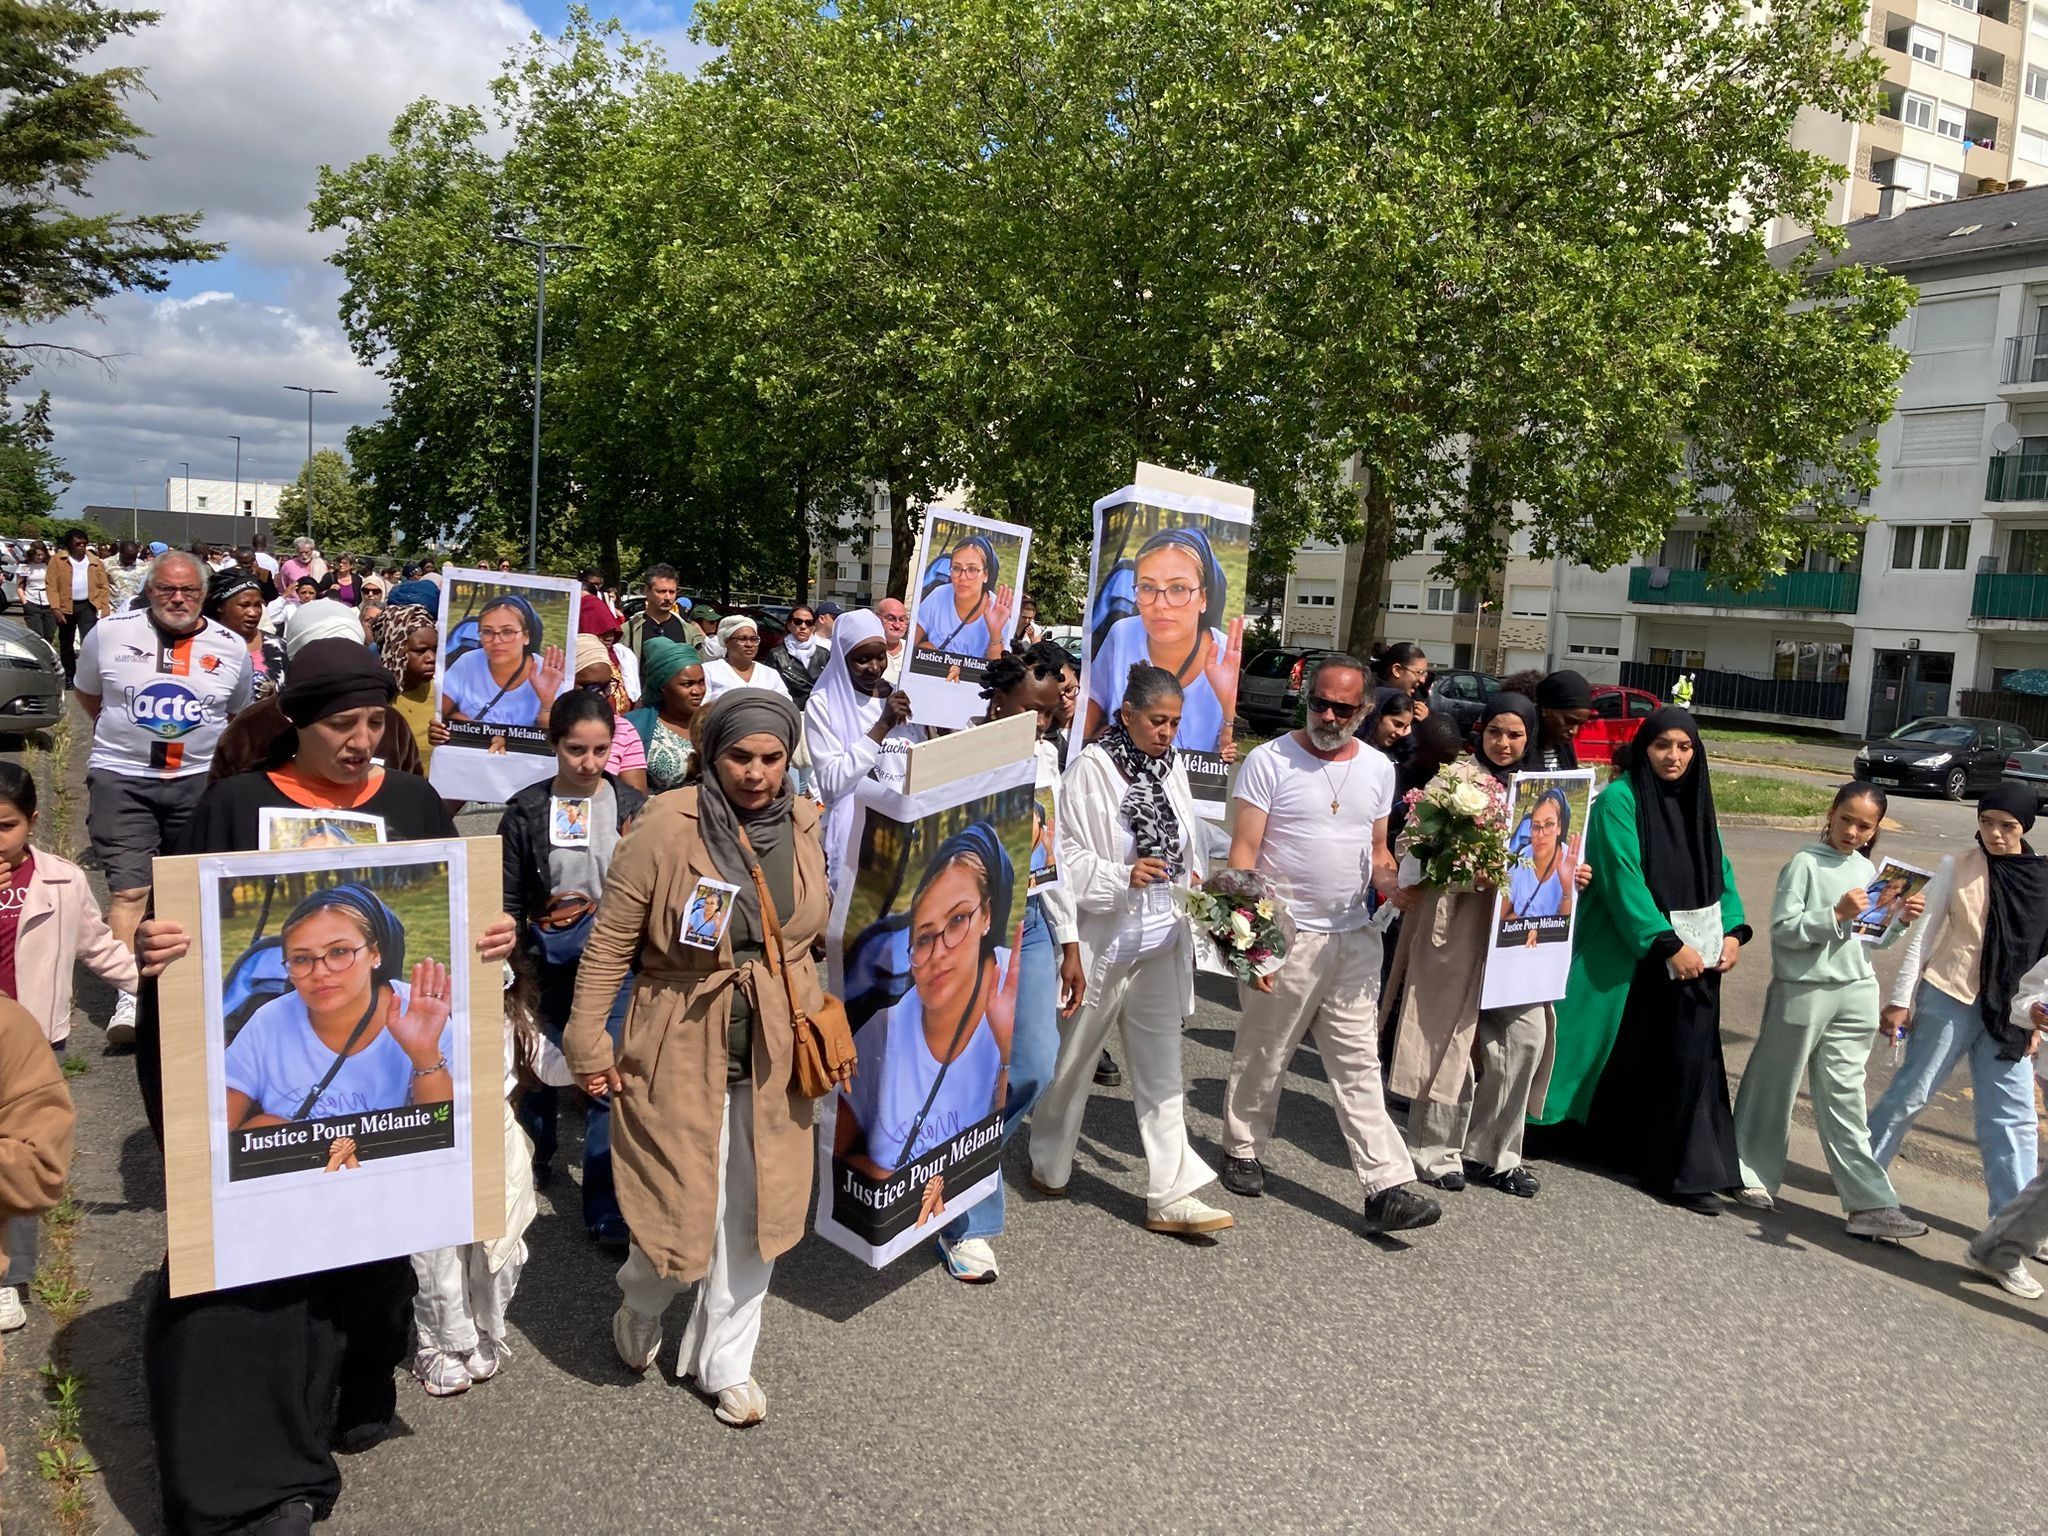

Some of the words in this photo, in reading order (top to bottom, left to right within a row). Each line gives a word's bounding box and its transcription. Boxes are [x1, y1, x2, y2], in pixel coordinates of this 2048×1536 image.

[915, 649, 943, 663] Justice
[943, 653, 962, 667] Pour
[962, 657, 989, 671] Mélan
[446, 720, 481, 734] Justice
[482, 724, 506, 736] Pour
[508, 727, 547, 740] Mélanie
[1502, 921, 1523, 933] Justice
[1523, 919, 1539, 930] Pour
[1539, 917, 1566, 929] Mélanie
[240, 1128, 308, 1153] Justice
[312, 1122, 356, 1142] Pour
[360, 1108, 431, 1135] Mélanie
[843, 1169, 905, 1210] Justice
[909, 1154, 947, 1191] Pour
